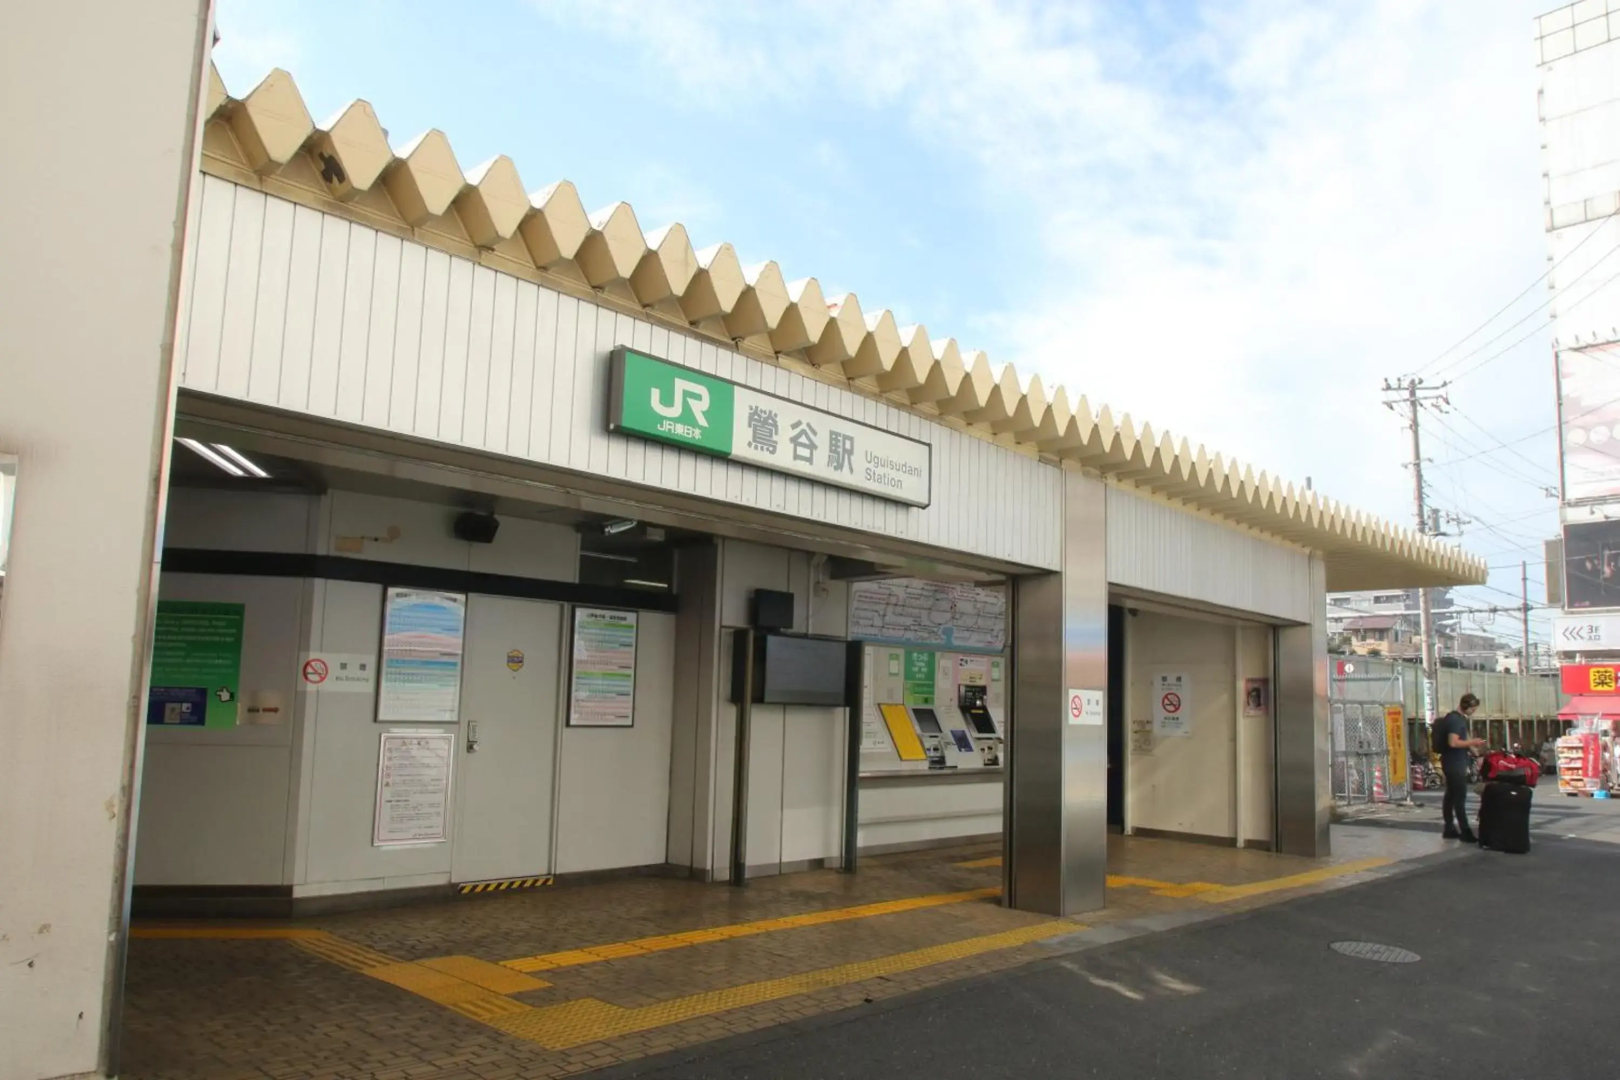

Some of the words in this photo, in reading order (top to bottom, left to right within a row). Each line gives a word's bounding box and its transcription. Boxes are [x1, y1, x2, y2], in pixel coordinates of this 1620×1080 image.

[650, 377, 711, 428] JR
[657, 419, 702, 440] JR東日本
[747, 405, 856, 475] 鶯谷駅
[865, 450, 922, 478] Uguisudani
[865, 468, 903, 490] Station
[1587, 624, 1601, 633] 3F
[1592, 670, 1613, 688] 薬
